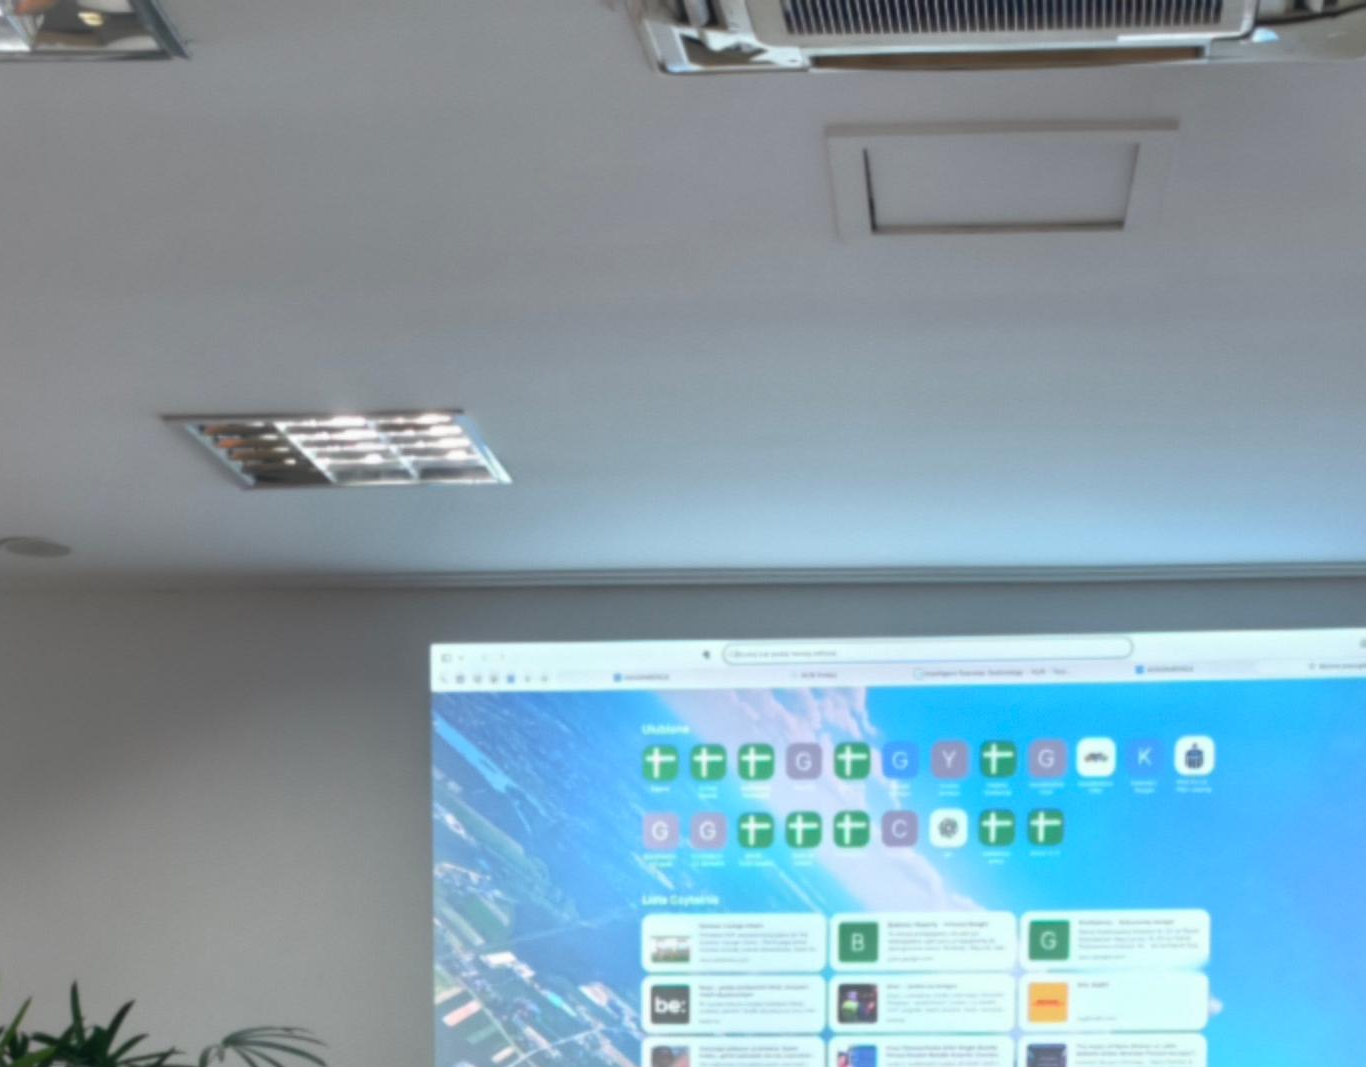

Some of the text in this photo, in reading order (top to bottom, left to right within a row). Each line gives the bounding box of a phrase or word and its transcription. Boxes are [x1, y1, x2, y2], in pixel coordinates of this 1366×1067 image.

[796, 753, 811, 771] G
[892, 751, 908, 769] G
[942, 750, 956, 768] Y
[1038, 749, 1054, 768] G
[1138, 747, 1151, 765] K
[652, 821, 668, 840] G
[700, 820, 716, 840] G
[891, 819, 907, 838] C
[851, 933, 865, 951] B
[1040, 931, 1057, 950] G
